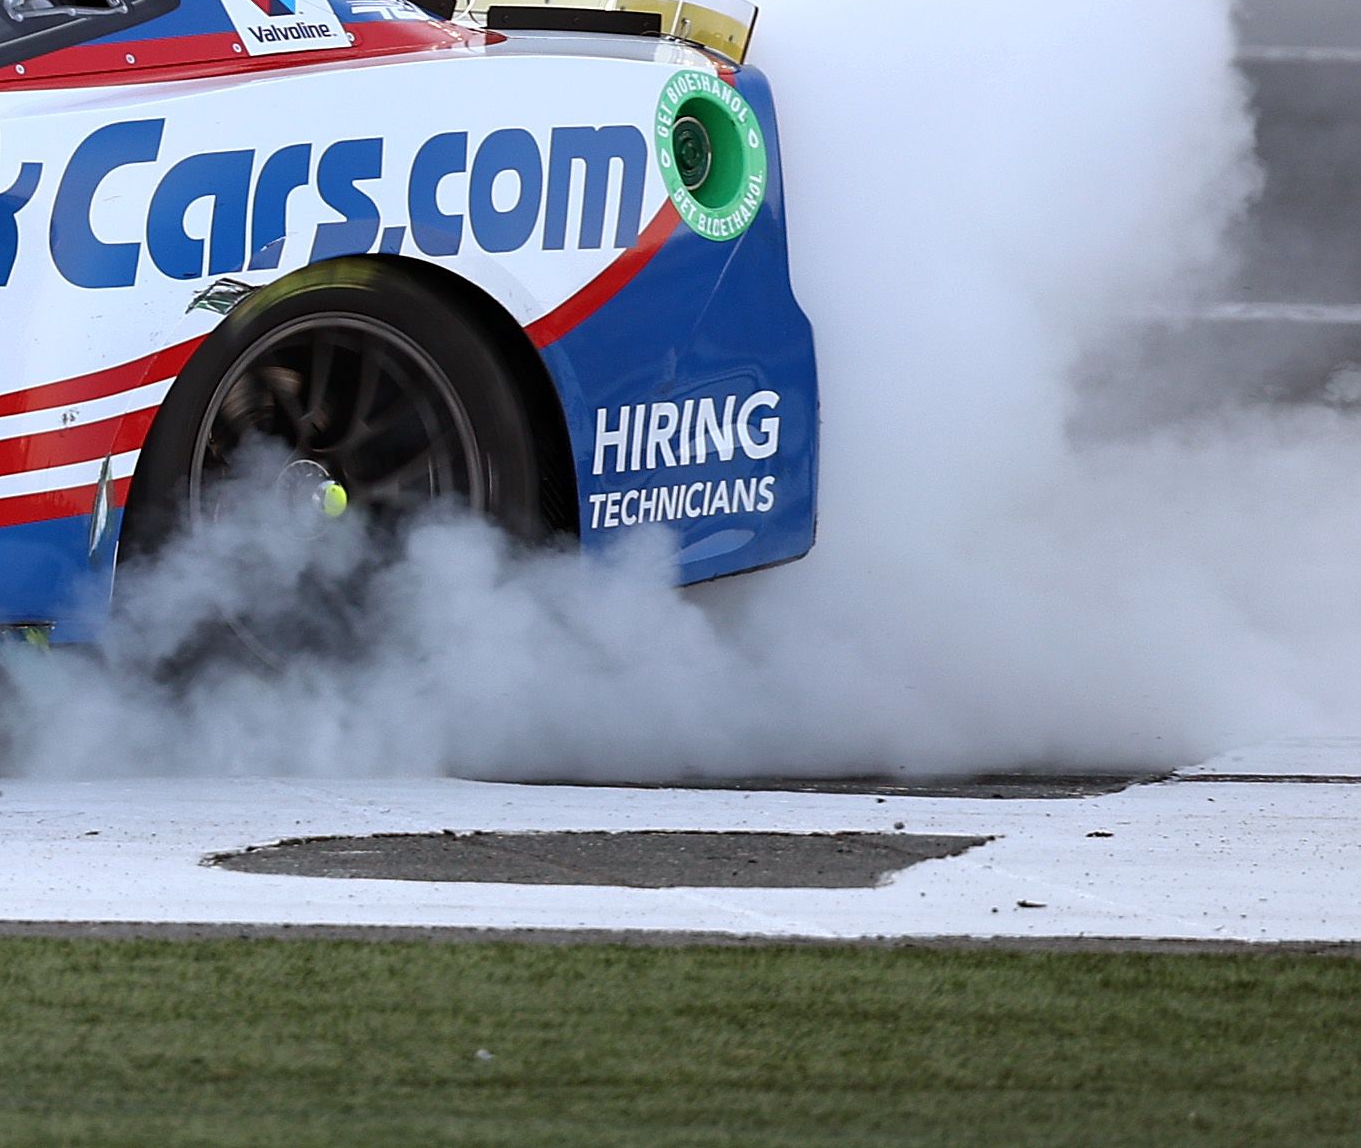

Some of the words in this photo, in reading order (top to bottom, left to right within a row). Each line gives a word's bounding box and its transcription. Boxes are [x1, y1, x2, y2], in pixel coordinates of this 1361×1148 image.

[248, 22, 330, 43] Valvoline
[657, 105, 672, 138] GET
[673, 187, 696, 221] GET
[592, 390, 780, 475] HIRING
[589, 475, 776, 529] TECHNICIANS
